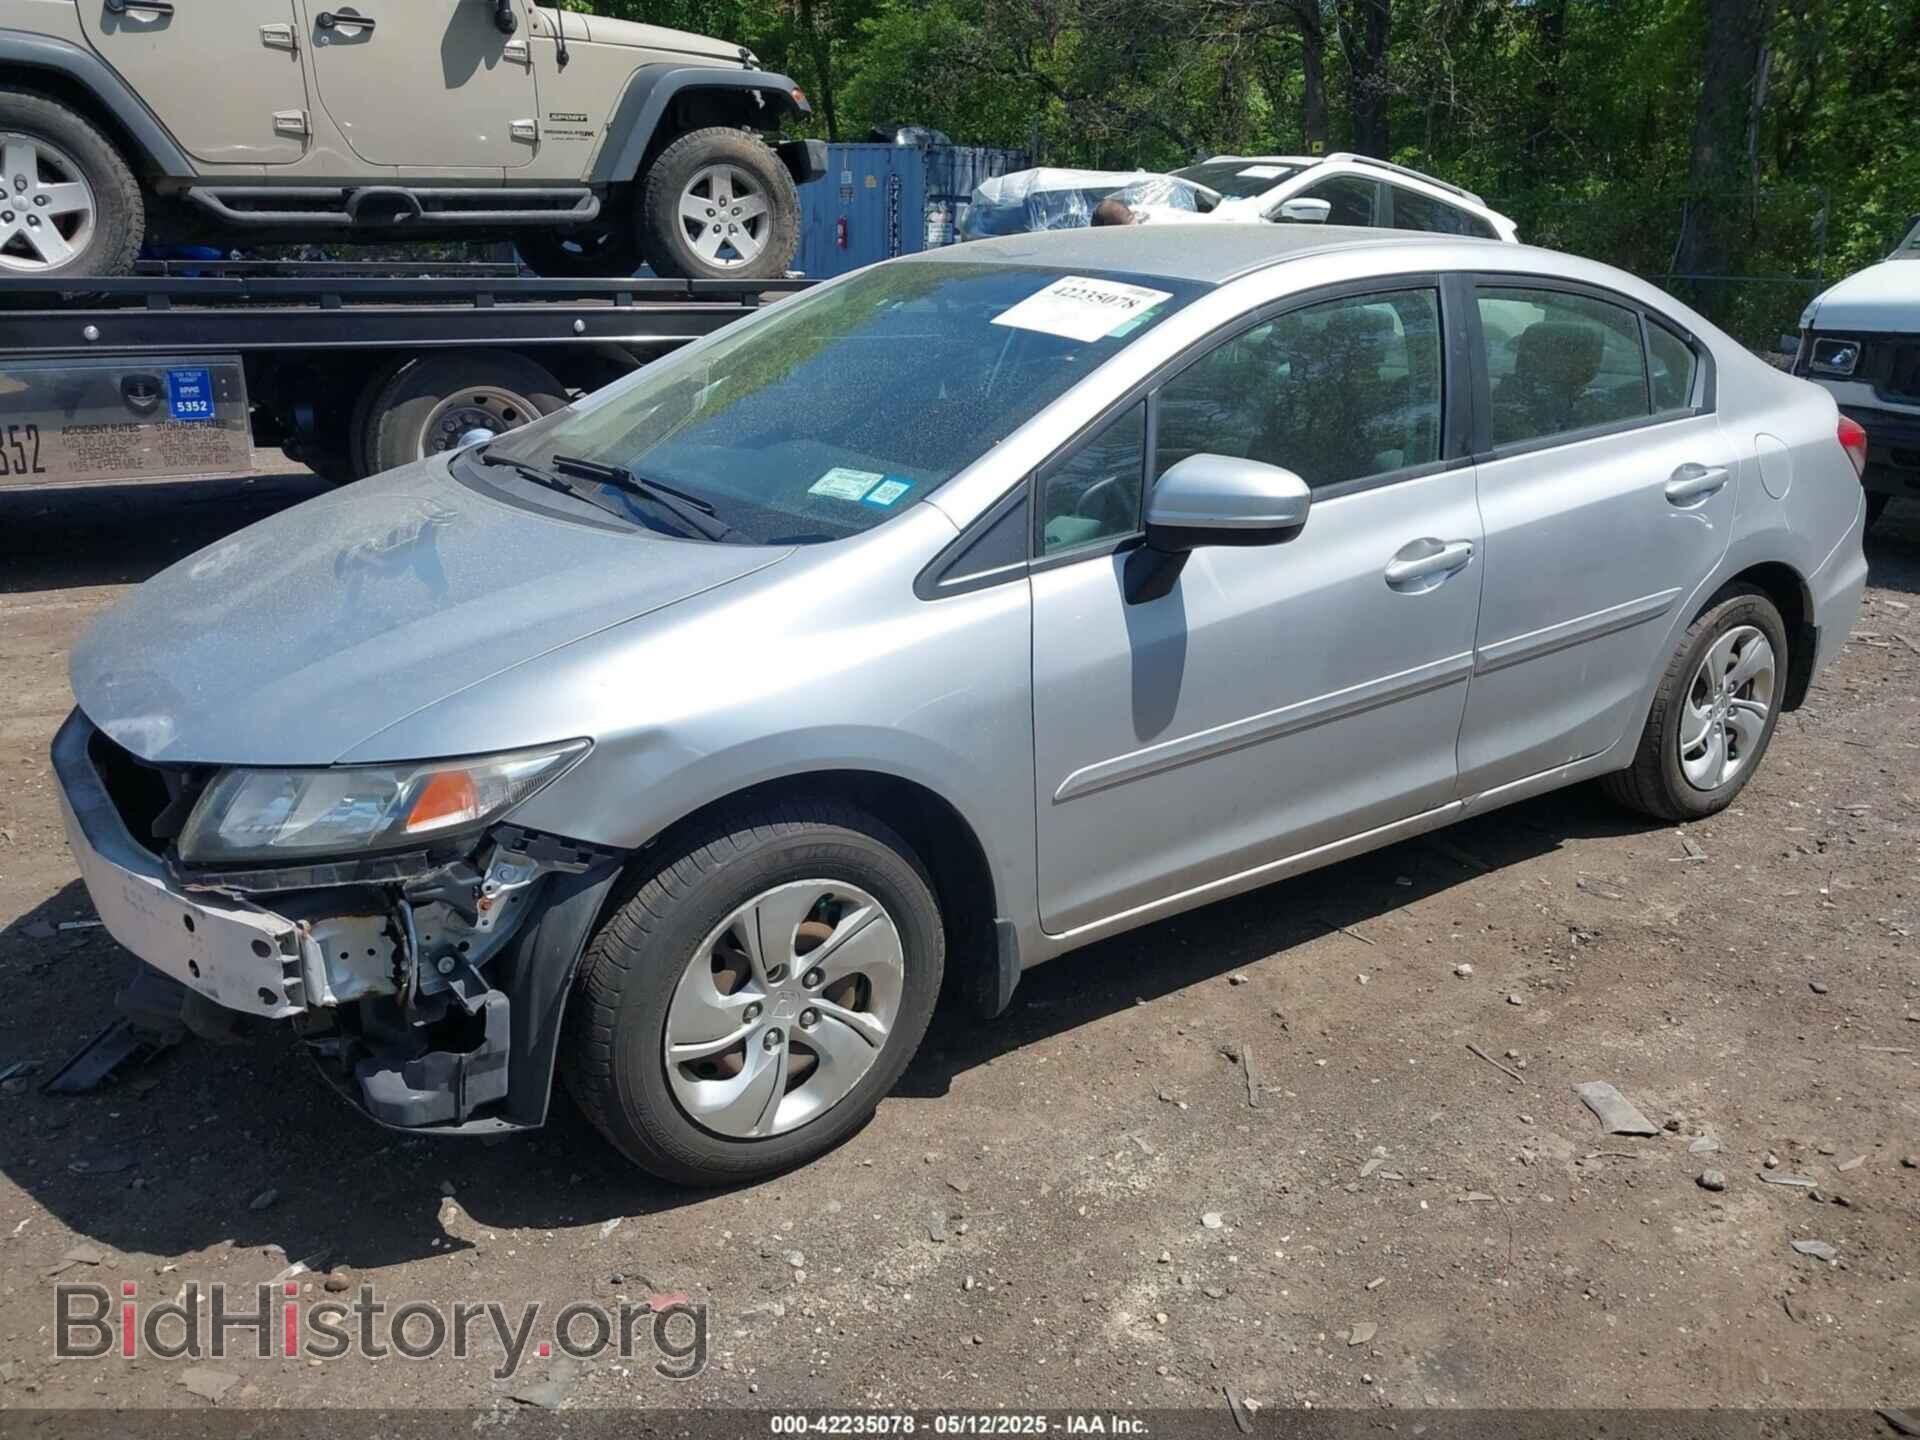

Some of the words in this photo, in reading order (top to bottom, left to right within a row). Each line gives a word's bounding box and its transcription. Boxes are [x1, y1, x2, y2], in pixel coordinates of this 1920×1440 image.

[176, 400, 208, 412] 5352
[62, 424, 109, 436] ACCIDENT
[110, 423, 141, 433] RATES
